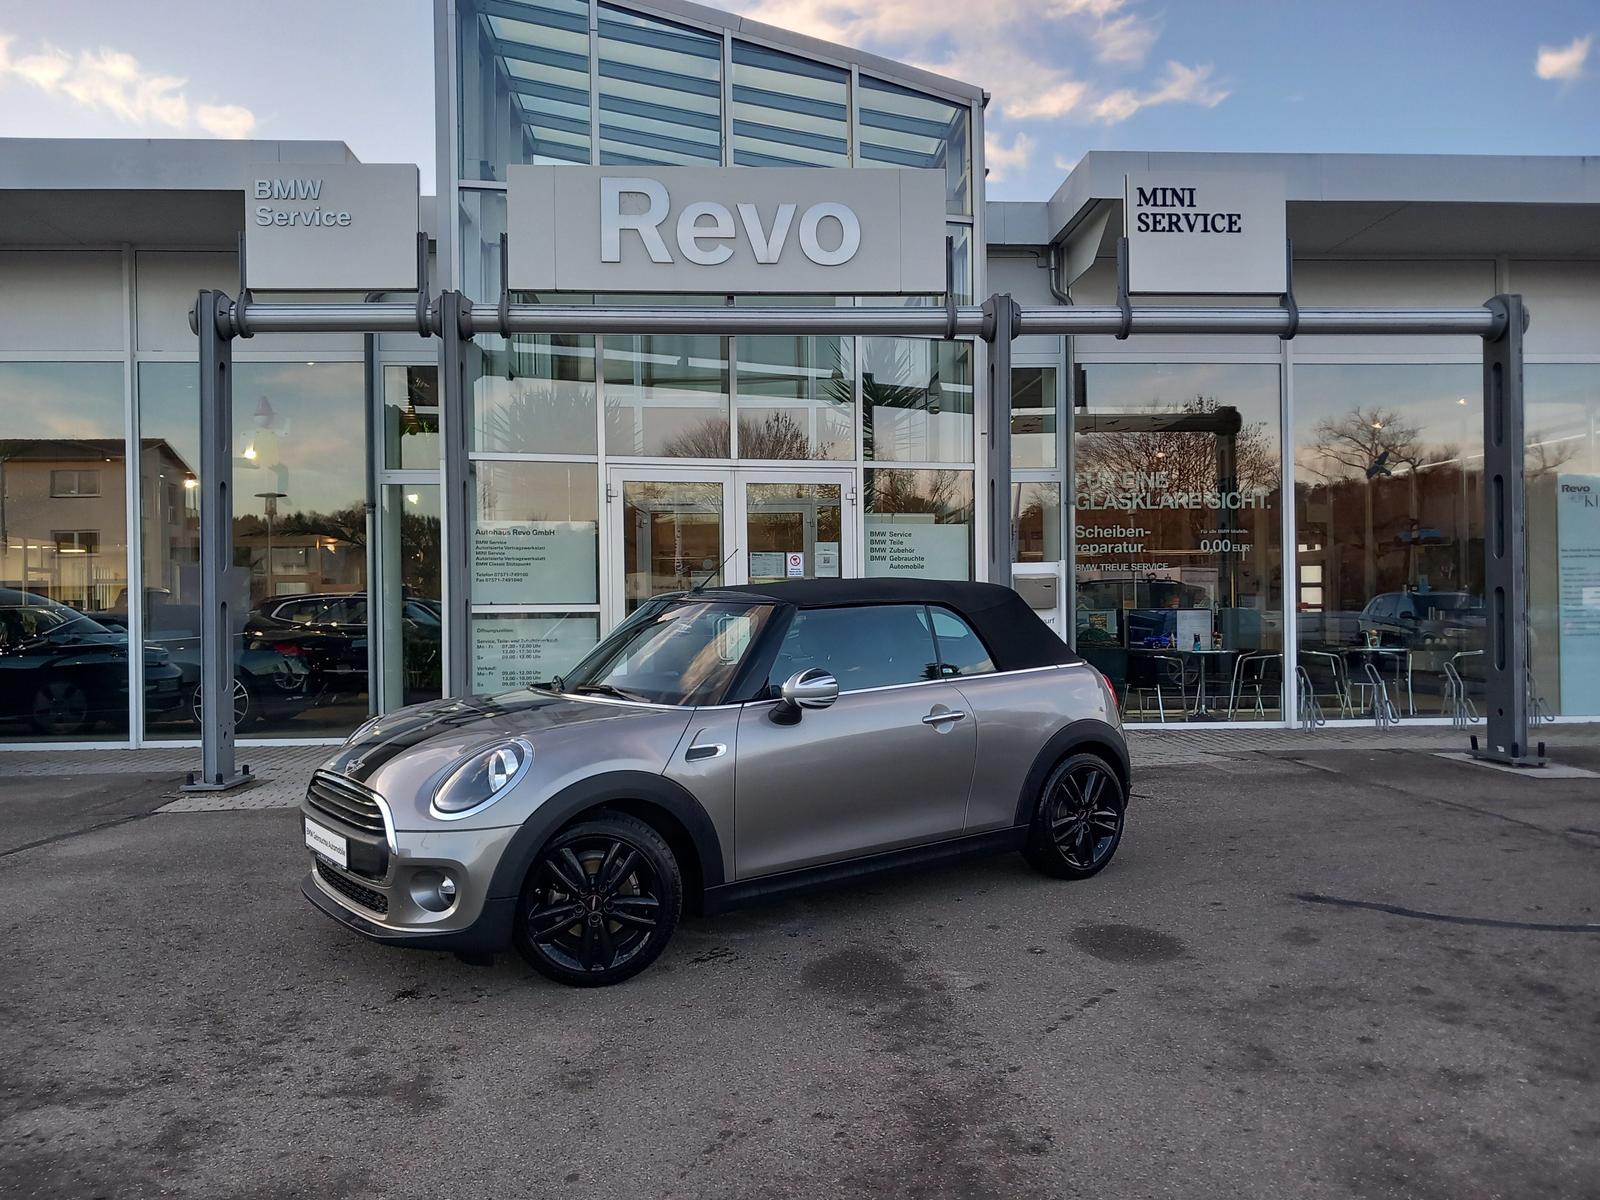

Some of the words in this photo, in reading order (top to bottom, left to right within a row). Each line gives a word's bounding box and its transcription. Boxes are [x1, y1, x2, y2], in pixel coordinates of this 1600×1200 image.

[254, 178, 323, 200] BMW
[1136, 186, 1197, 208] MINI
[255, 205, 352, 227] Service
[600, 176, 861, 266] Revo
[1137, 212, 1242, 233] SERVICE
[1122, 471, 1168, 489] EINE
[1561, 484, 1590, 493] Revo
[1075, 492, 1201, 510] GLASKLARE
[1209, 491, 1272, 510] SICHT.
[475, 528, 511, 536] Autohaus
[512, 528, 531, 536] Revo
[532, 528, 556, 536] GmbH
[1075, 524, 1152, 538] Scheiben-
[1076, 542, 1147, 556] reparatur.
[1200, 539, 1231, 555] 0,00
[1076, 563, 1098, 572] BMW
[1100, 563, 1129, 571] TREUE
[1131, 562, 1169, 571] SERVICE
